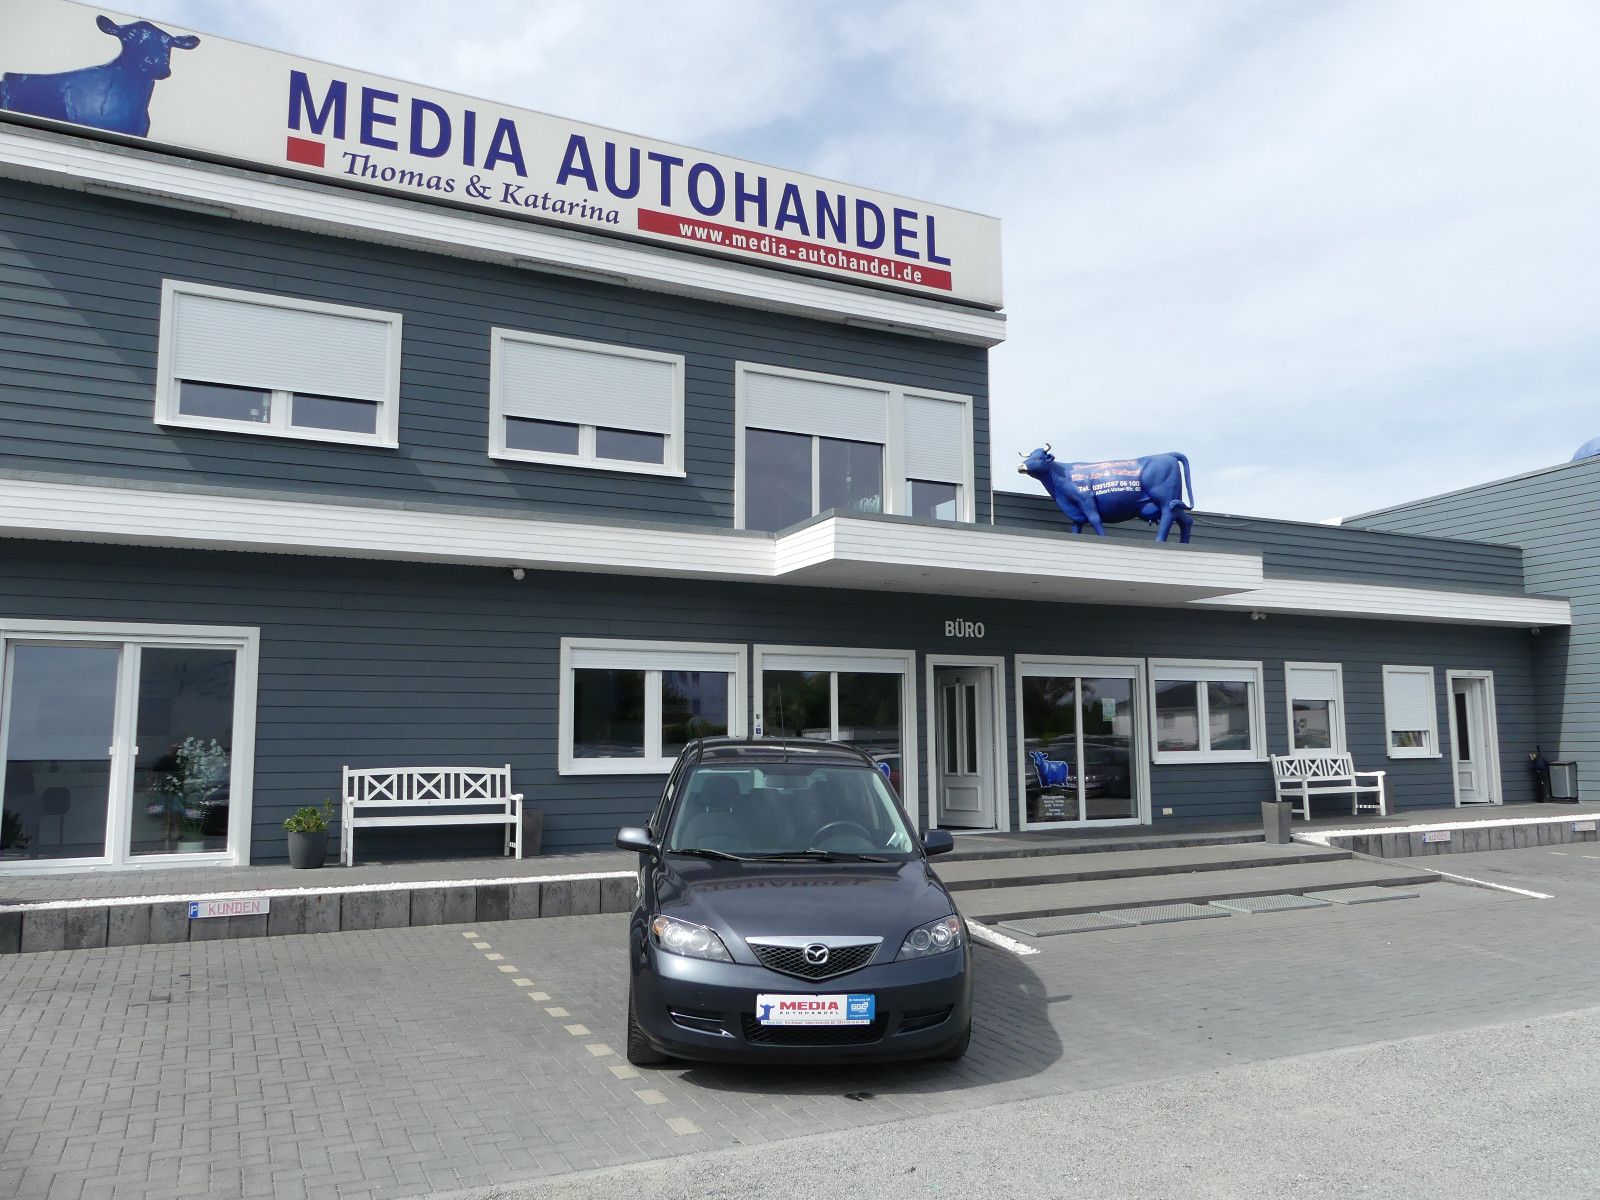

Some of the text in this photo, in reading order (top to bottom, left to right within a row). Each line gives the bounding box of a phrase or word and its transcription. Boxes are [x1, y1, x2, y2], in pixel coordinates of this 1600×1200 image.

[287, 69, 952, 266] MEDIA AUTOHANDEL
[342, 151, 620, 225] Thomas & Katarina
[679, 221, 923, 284] www.media-autohandel.de
[944, 618, 985, 639] BÜRO
[207, 900, 260, 916] KUNDEN
[779, 1001, 839, 1010] MEDIA
